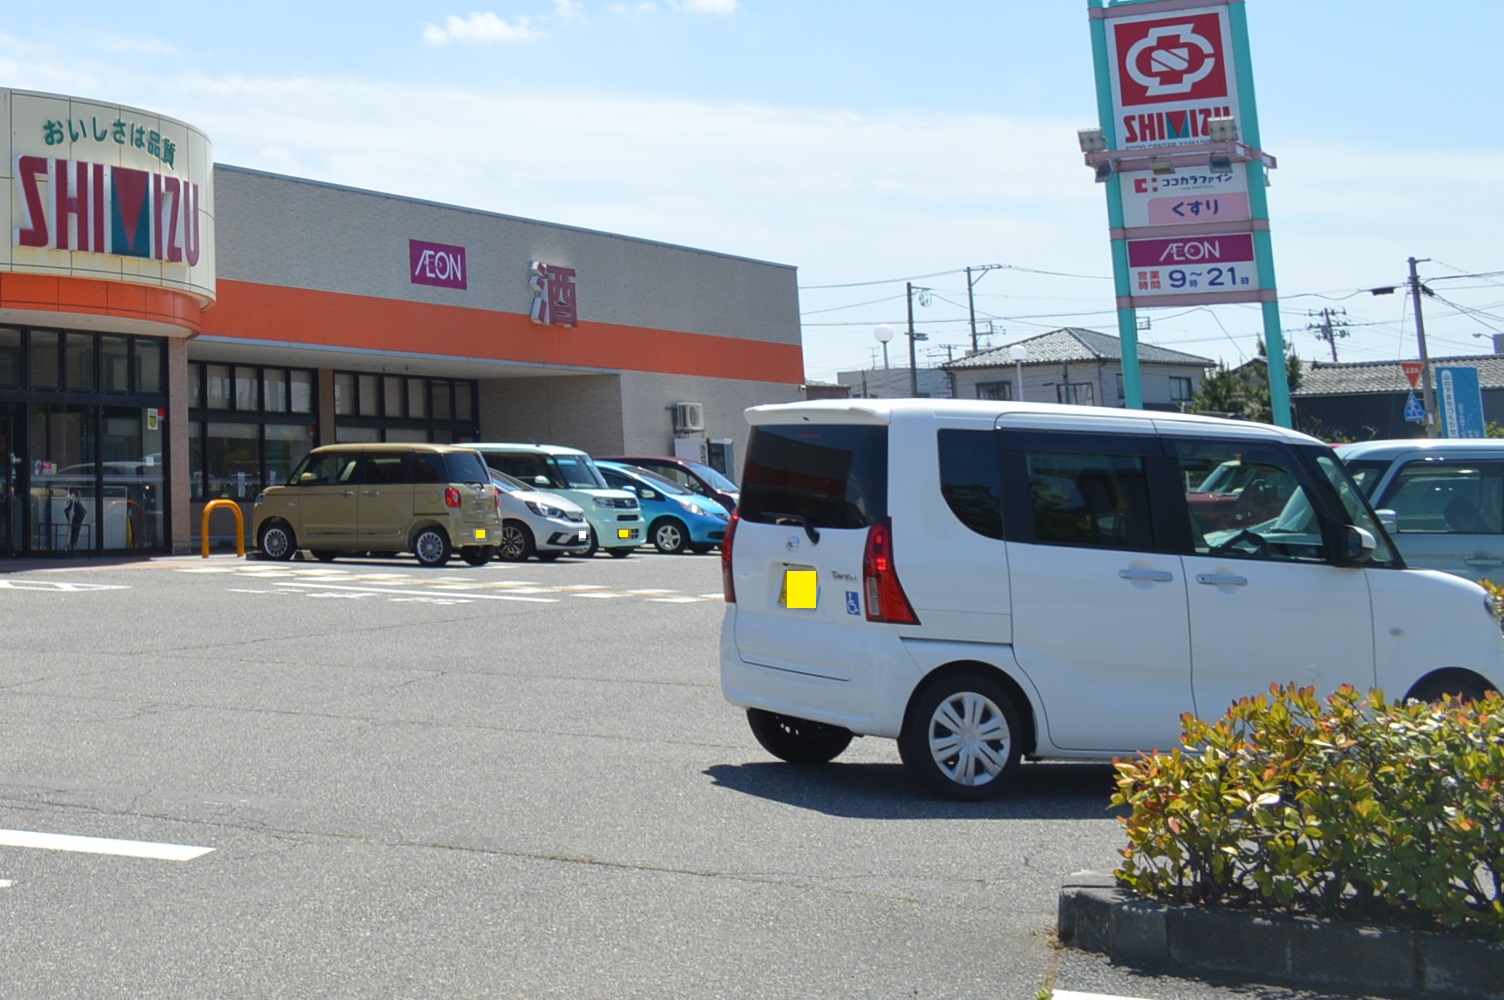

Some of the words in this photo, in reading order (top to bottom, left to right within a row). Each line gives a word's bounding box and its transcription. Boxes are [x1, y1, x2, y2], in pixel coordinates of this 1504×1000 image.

[43, 116, 176, 170] おいしさは品質
[1161, 173, 1233, 187] ココカラファイン
[14, 155, 200, 267] SHIMIZU
[1172, 199, 1219, 216] くすり
[529, 261, 578, 327] 酒
